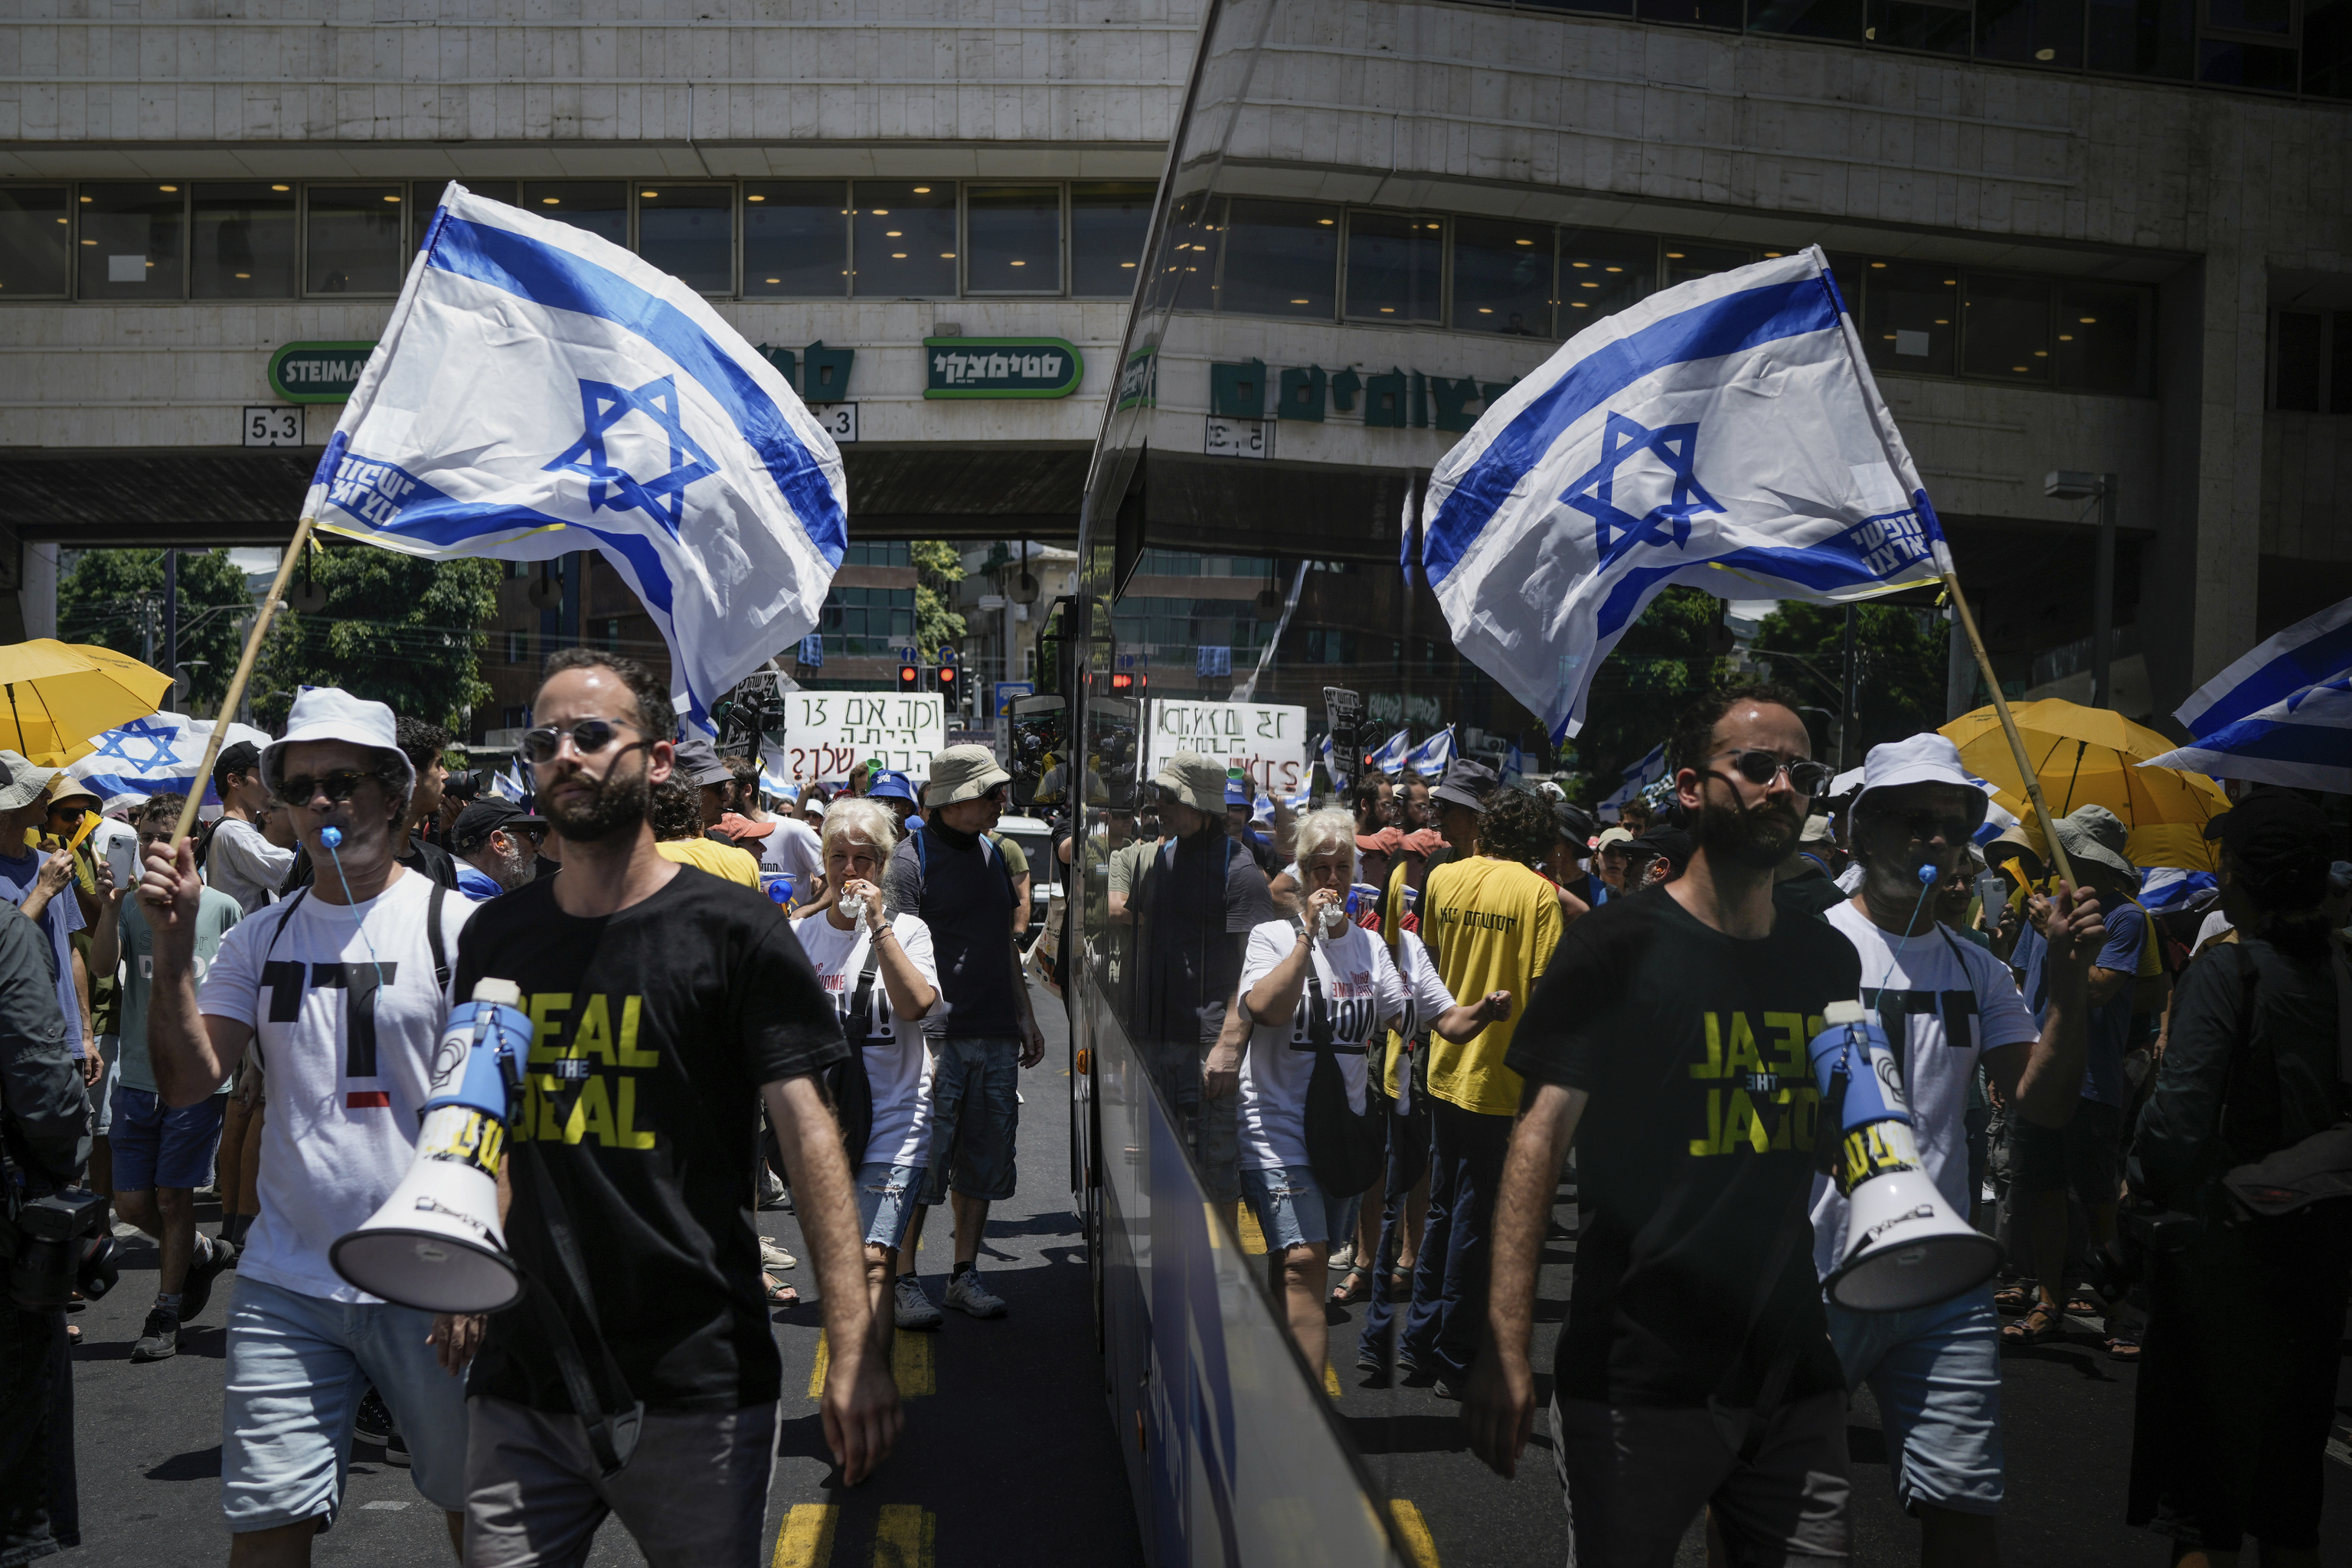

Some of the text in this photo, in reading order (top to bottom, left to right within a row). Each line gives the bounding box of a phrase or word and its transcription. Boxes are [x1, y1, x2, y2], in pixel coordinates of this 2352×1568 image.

[286, 360, 368, 383] STEIMA
[933, 352, 1063, 384] סטימצקי
[252, 416, 297, 439] 5.3
[812, 412, 851, 433] .3
[1861, 533, 1930, 577] ארצנו
[802, 698, 939, 730] ומה אם זו
[841, 728, 918, 745] היתה
[789, 742, 855, 780] שלך?
[518, 992, 660, 1067] EAL
[556, 1060, 590, 1078] THE
